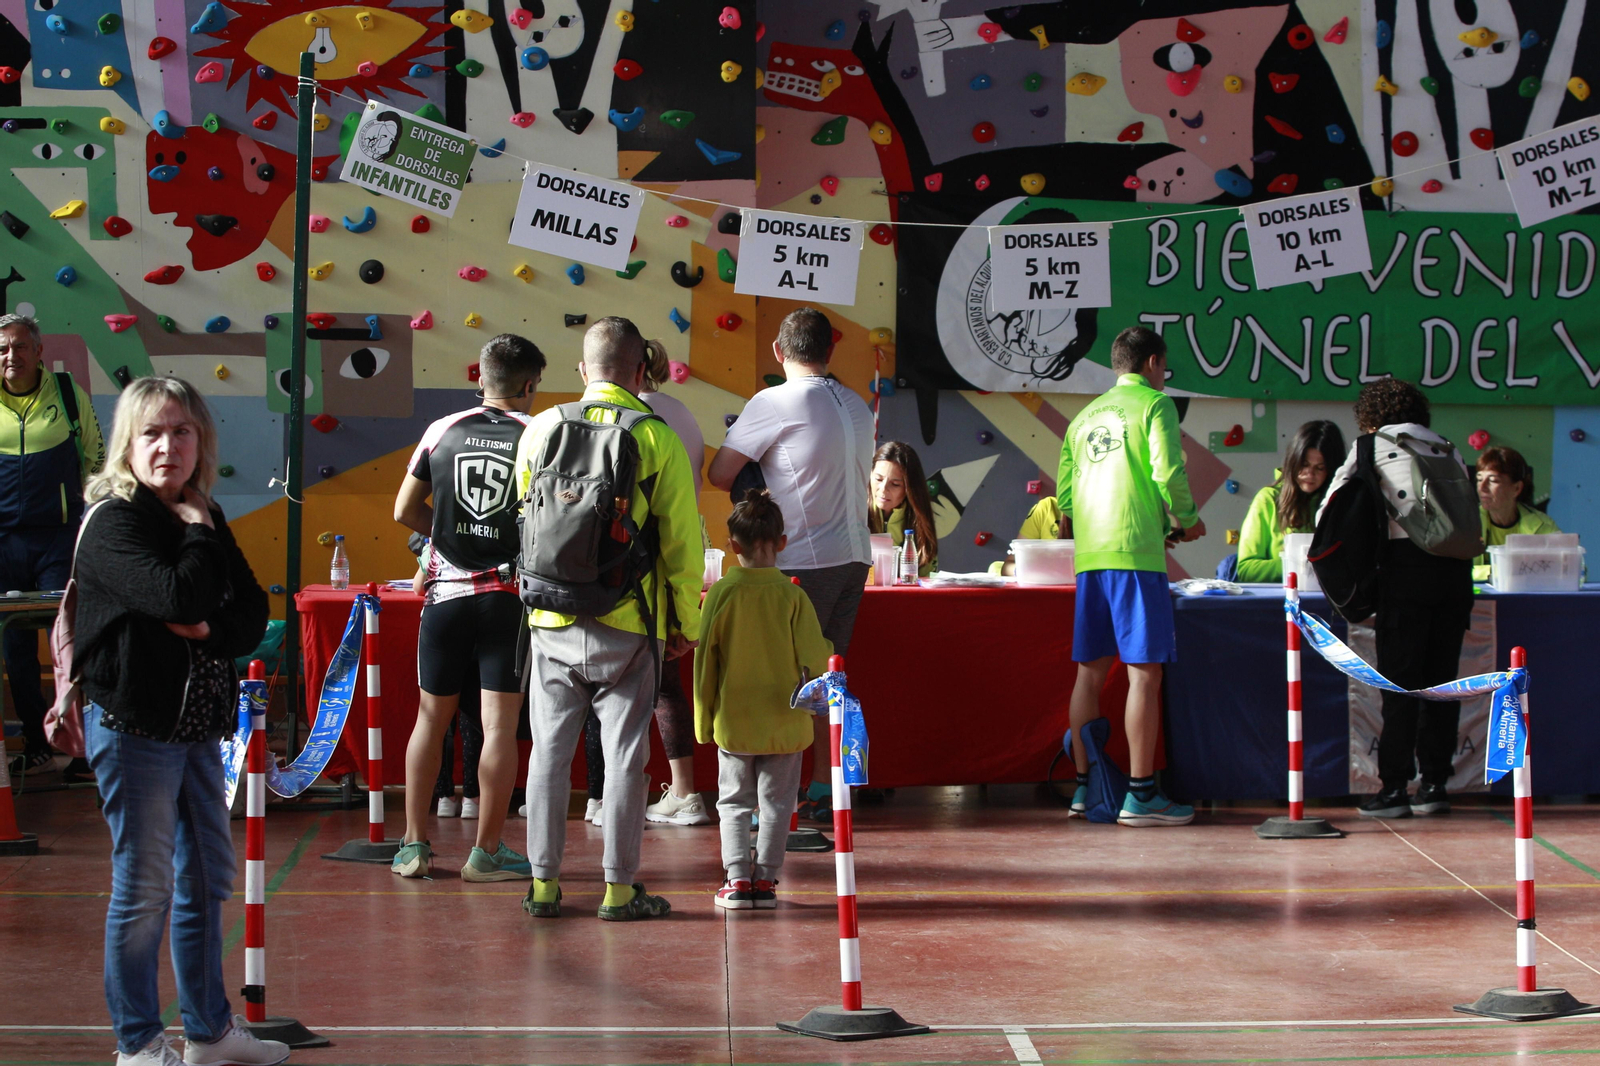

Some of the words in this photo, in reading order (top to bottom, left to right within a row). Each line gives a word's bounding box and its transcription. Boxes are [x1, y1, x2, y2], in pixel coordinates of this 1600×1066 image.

[410, 126, 465, 156] ENTREGA
[424, 147, 443, 164] DE
[1512, 126, 1600, 167] DORSALES
[395, 153, 460, 187] DORSALES
[1533, 166, 1557, 187] 10
[1563, 157, 1597, 178] km
[350, 161, 452, 211] INFANTILES
[536, 173, 631, 209] DORSALES
[1548, 177, 1596, 208] M-Z
[530, 208, 618, 246] MILLAS
[1258, 197, 1350, 228] DORSALES
[756, 218, 851, 242] DORSALES
[1004, 232, 1098, 250] DORSALES
[1276, 230, 1301, 252] 10
[1309, 225, 1341, 246] km
[773, 244, 788, 264] 5
[796, 245, 829, 268] km
[1025, 258, 1038, 276] 5
[1048, 256, 1081, 275] km
[1147, 217, 1596, 299] BIEVENID
[1294, 251, 1334, 273] A-L
[778, 270, 819, 291] A-L
[1028, 280, 1078, 300] M-Z
[969, 289, 985, 304] DEL
[969, 306, 999, 356] ESPARTANOS
[1420, 316, 1539, 390] DEL
[465, 436, 513, 451] ATLETISMO
[460, 458, 509, 514] GS
[455, 522, 500, 540] ALMERIA
[1502, 694, 1512, 708] de
[1506, 696, 1521, 766] Ayuntamiento
